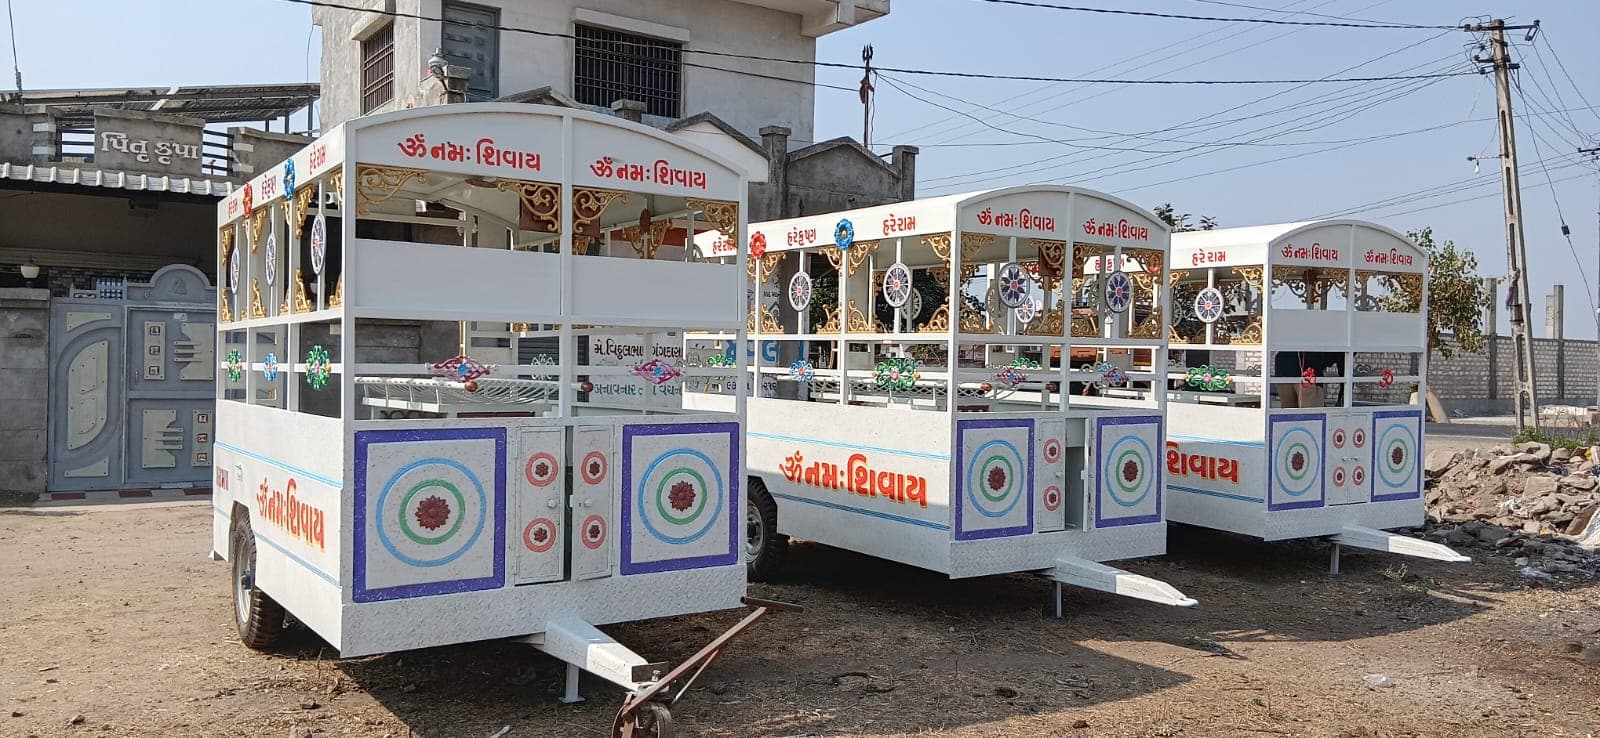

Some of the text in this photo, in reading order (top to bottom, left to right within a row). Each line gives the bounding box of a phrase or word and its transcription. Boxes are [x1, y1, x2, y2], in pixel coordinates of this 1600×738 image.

[101, 132, 199, 165] પિતૃ કૃપા
[476, 138, 541, 171] શિવાય
[654, 159, 706, 189] શિવાય
[1020, 208, 1055, 232] શિવાય
[1118, 218, 1148, 241] શિવાય
[847, 453, 928, 508] શિવાય
[286, 478, 326, 550] શિવાય
